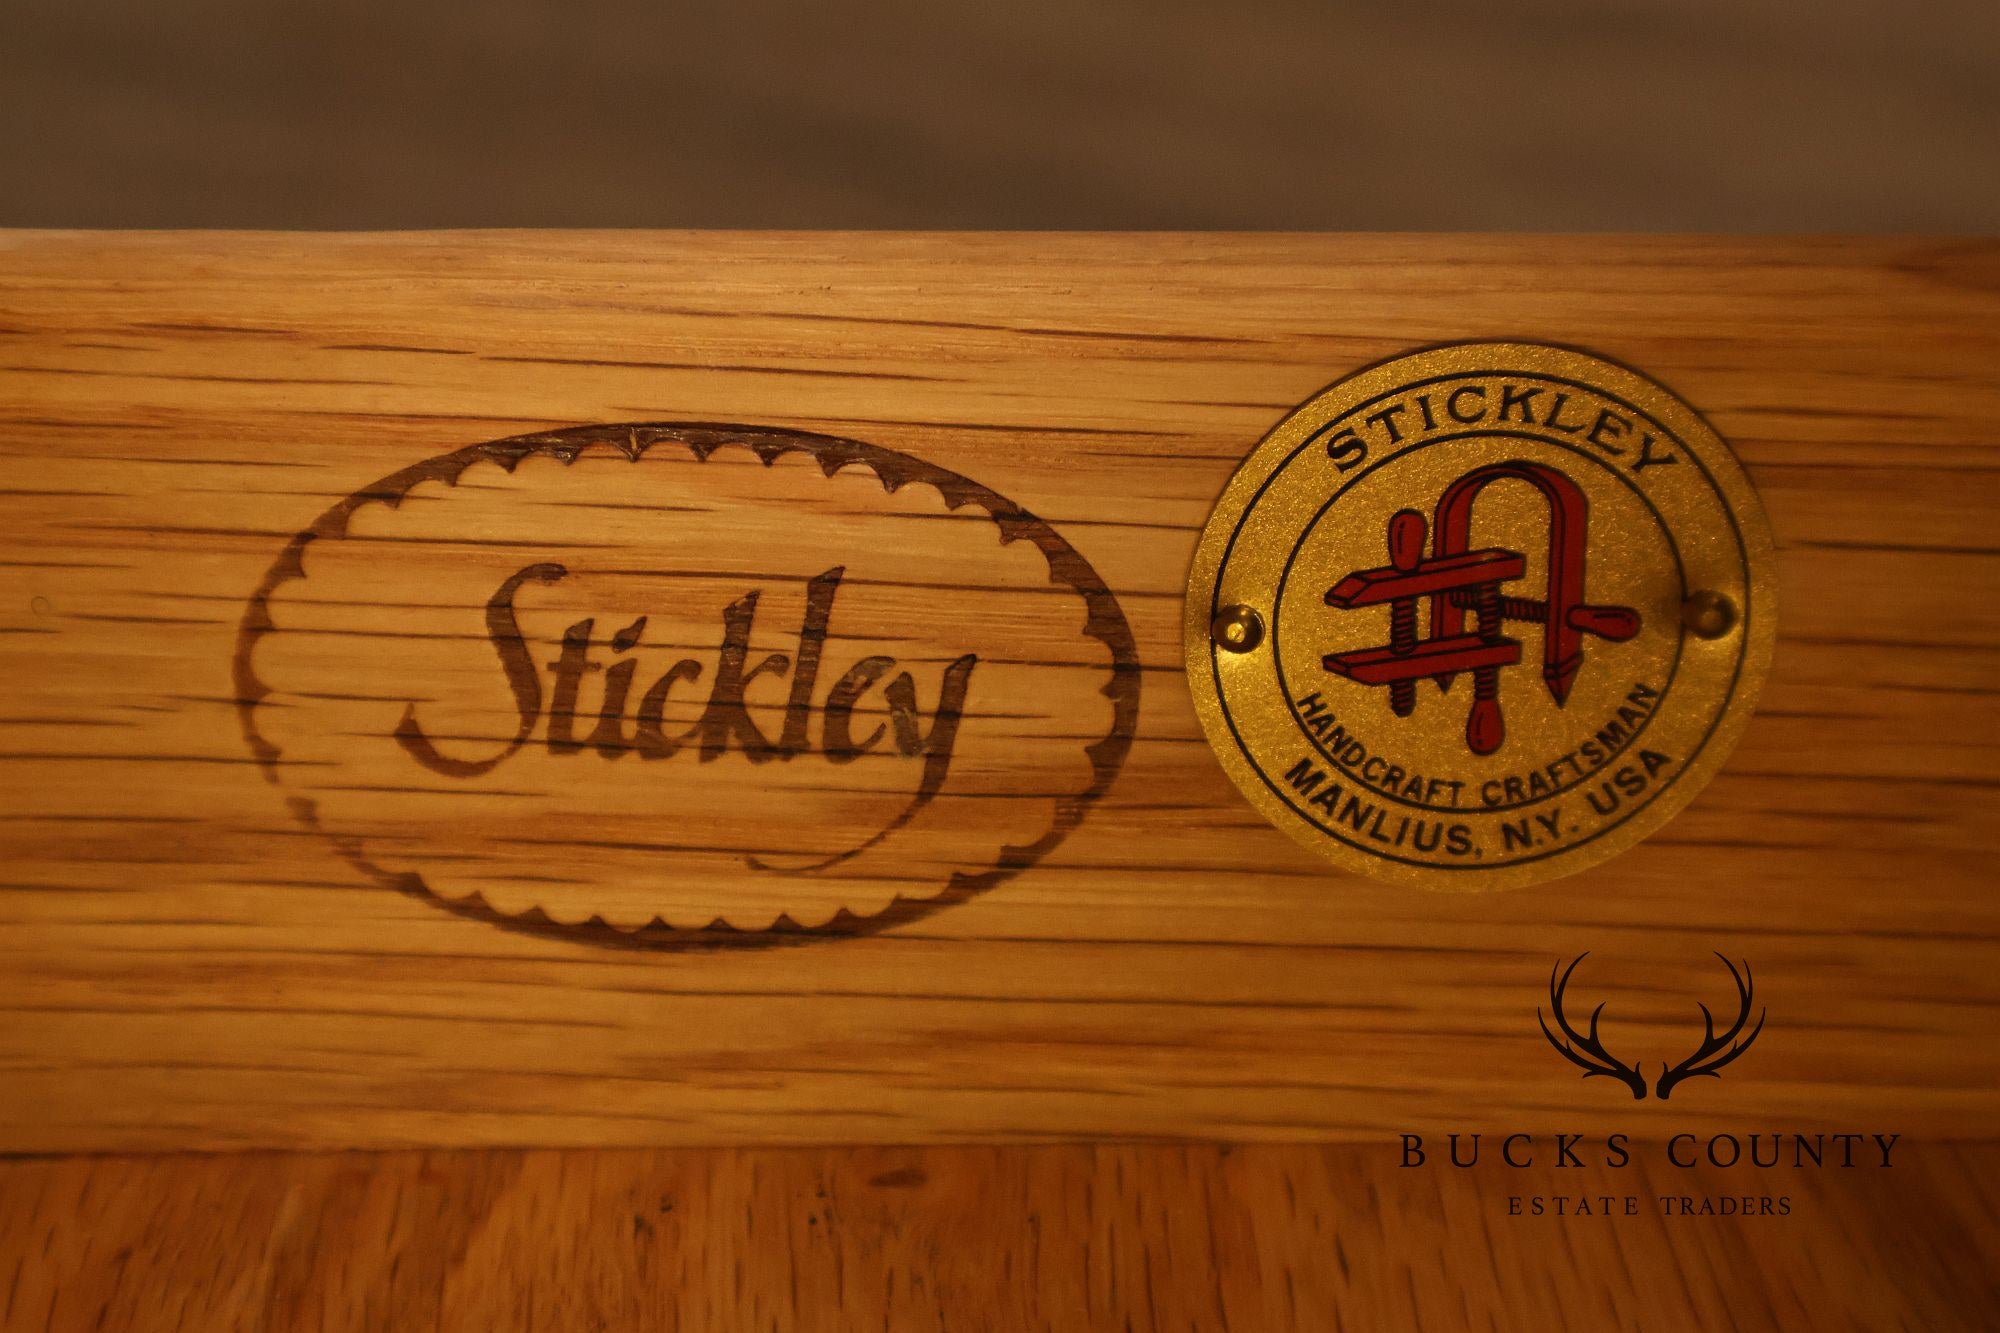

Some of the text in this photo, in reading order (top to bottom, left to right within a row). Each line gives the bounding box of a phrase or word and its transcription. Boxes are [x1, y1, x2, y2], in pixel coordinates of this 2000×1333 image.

[1325, 384, 1680, 474] STICKLEY
[394, 562, 978, 873] Stickley
[1295, 682, 1660, 807] HANDCRAFT CRAFTSMAN
[1283, 746, 1674, 859] MANLIUS, N.Y. USA
